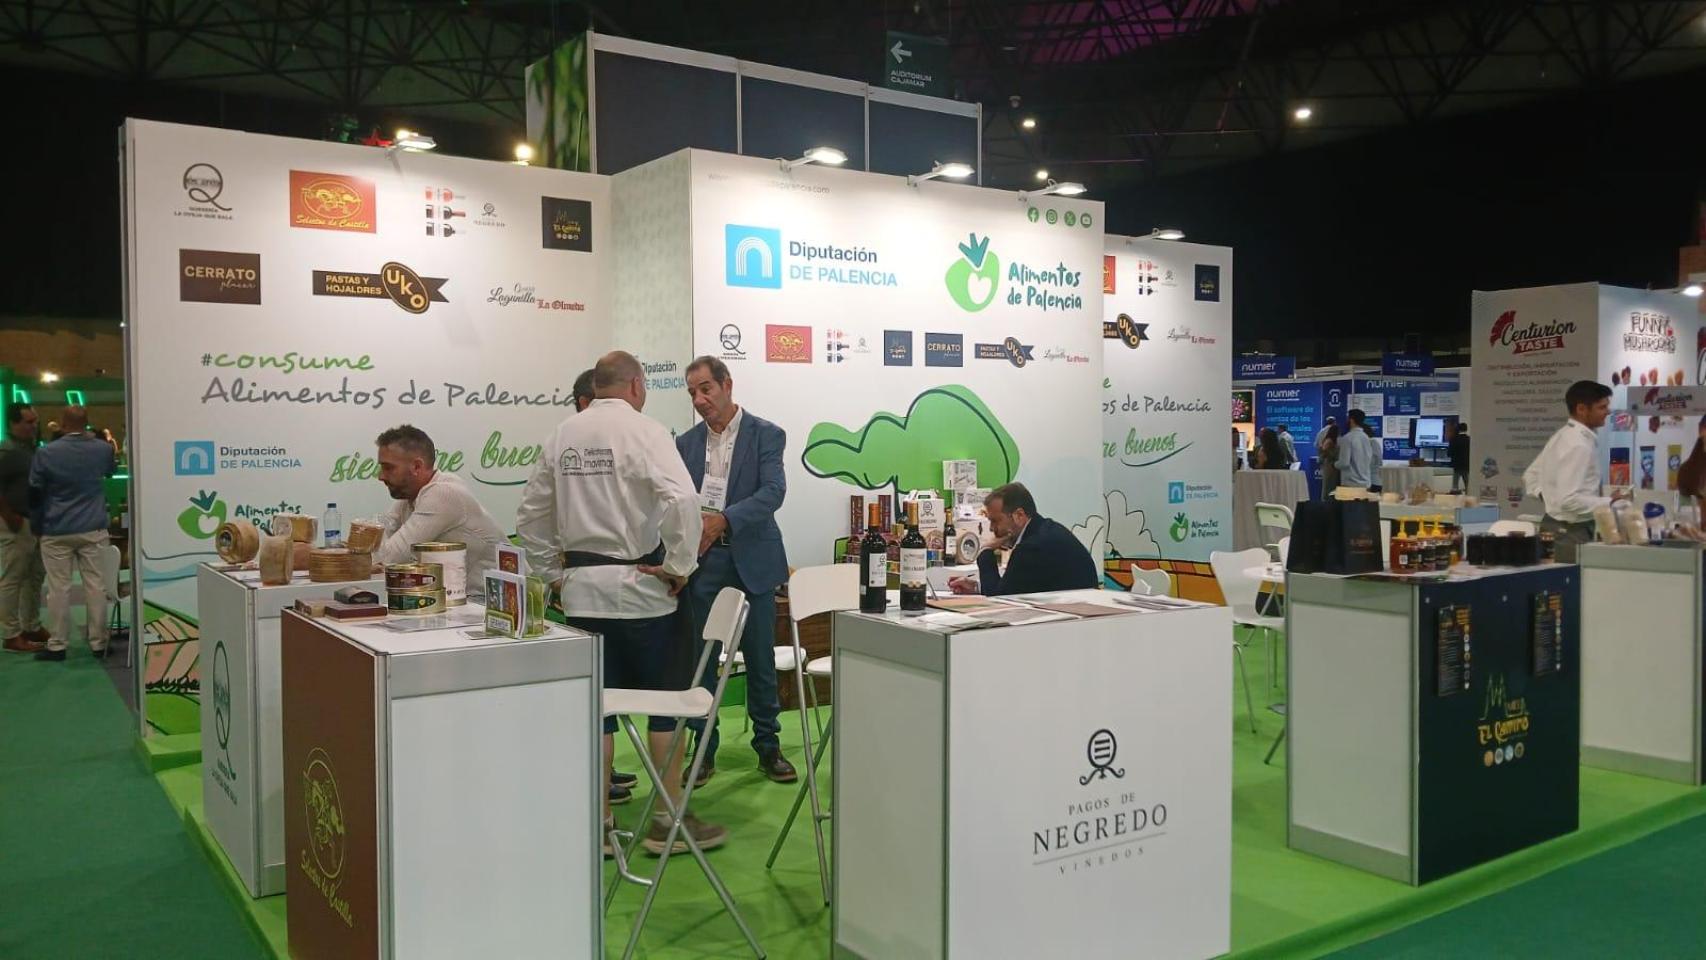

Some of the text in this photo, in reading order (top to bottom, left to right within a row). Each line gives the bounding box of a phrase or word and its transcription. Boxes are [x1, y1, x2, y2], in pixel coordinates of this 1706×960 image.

[789, 240, 878, 263] Diputación
[184, 265, 257, 281] CERRATO
[325, 274, 370, 286] PASTAS Y
[789, 265, 898, 287] DE PALENCIA
[1008, 261, 1081, 288] Alimentos
[325, 285, 382, 295] HOJALDRES
[1007, 285, 1082, 312] de Palencia
[1502, 319, 1577, 346] Centurion
[1630, 312, 1673, 335] FUNNY
[927, 342, 961, 352] CERRATO
[1519, 338, 1559, 351] TASTE
[1624, 333, 1676, 353] MUSHROOMS
[201, 352, 375, 374] #consume
[640, 359, 677, 376] iputación
[201, 376, 578, 409] Alimentos de Palencia
[1266, 389, 1300, 398] numier
[1122, 394, 1140, 412] de
[1144, 395, 1212, 413] Palencia
[220, 446, 287, 458] Diputación
[220, 459, 302, 469] DE PALENCIA
[234, 500, 302, 517] Alimentos
[1068, 791, 1136, 816] PAGOS DE
[1032, 803, 1168, 856] NEGREDO
